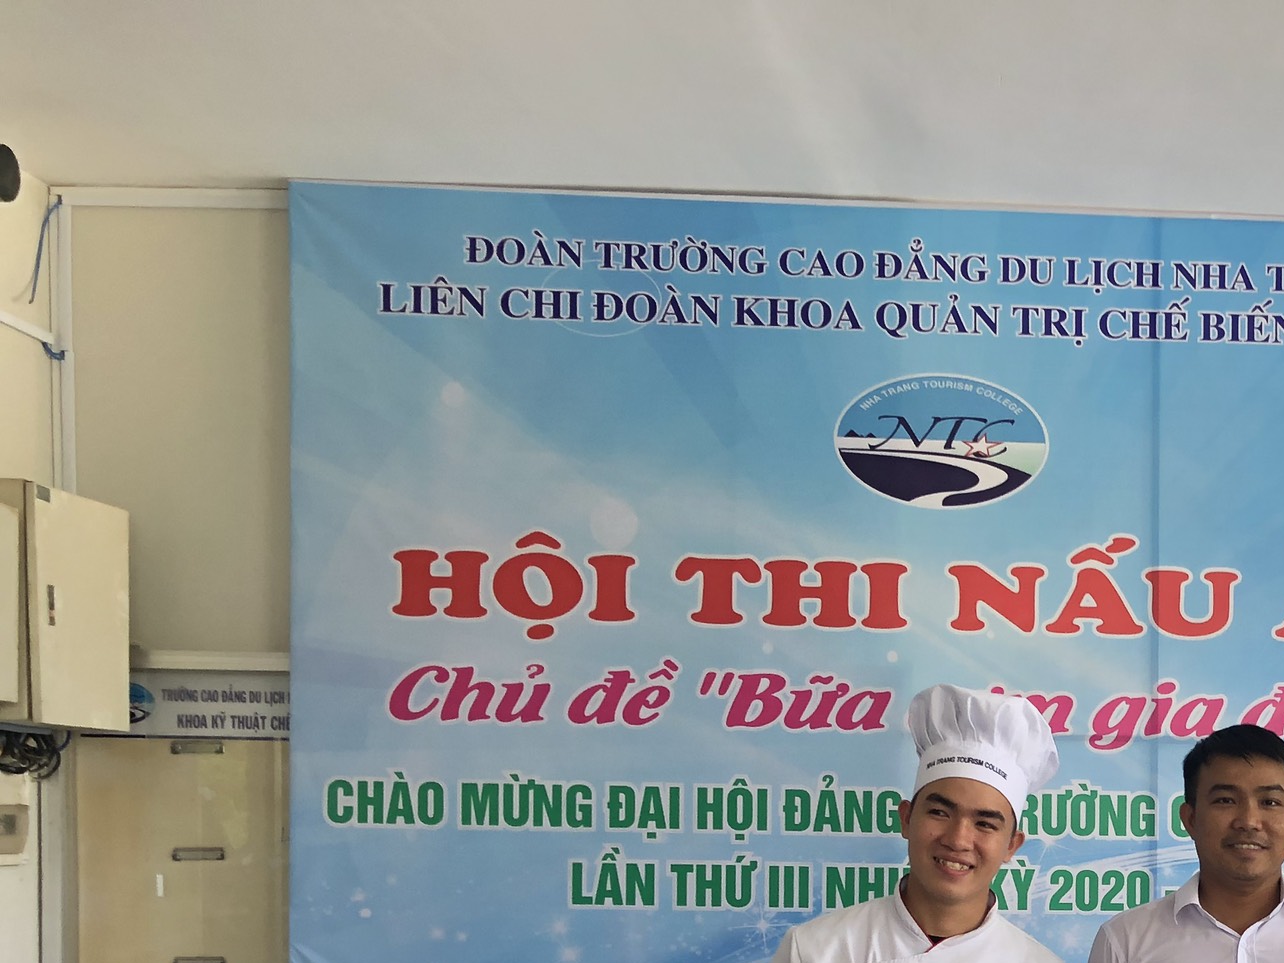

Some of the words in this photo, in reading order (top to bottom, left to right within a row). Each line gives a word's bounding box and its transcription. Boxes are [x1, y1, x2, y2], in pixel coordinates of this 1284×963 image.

[465, 229, 584, 268] ĐOÀN
[593, 238, 766, 277] TRƯỜNG
[778, 248, 865, 279] CAO
[875, 237, 988, 286] ĐẲNG
[1000, 255, 1054, 287] DU
[1065, 258, 1162, 294] LỊCH
[1172, 261, 1256, 292] NHA
[379, 276, 487, 318] LIÊN
[500, 287, 583, 322] CHI
[593, 284, 720, 327] ĐOÀN
[732, 296, 862, 331] KHOA
[875, 293, 1000, 339] QUẢN
[1012, 306, 1087, 346] TRỊ
[1098, 296, 1191, 342] CHẾ
[859, 395, 883, 412] NHA
[881, 380, 920, 400] TRANG
[923, 380, 974, 392] TOURISM
[976, 386, 1024, 416] COLLEGE
[867, 414, 1016, 459] NTC
[391, 530, 637, 641] HỘI
[674, 555, 909, 629] THI
[949, 534, 1239, 640] NẤU
[161, 686, 198, 703] TRƯỜNG
[200, 689, 219, 703] CAO
[221, 683, 247, 704] ĐẲNG
[249, 690, 262, 704] DU
[264, 691, 285, 707] LỊCH
[176, 713, 208, 730] KHOA
[211, 711, 227, 730] KỸ
[230, 712, 267, 733] THUẬT
[388, 662, 552, 724] Chủ
[567, 658, 680, 727] đề
[699, 670, 894, 732] "Bữa
[1089, 681, 1223, 750] gia
[936, 756, 956, 765] TRANG
[956, 756, 984, 767] TOURISM
[984, 761, 1008, 781] COLLEGE
[325, 771, 444, 826] CHÀO
[460, 773, 594, 829] MỪNG
[607, 784, 681, 840] ĐẠI
[695, 778, 769, 842] HỘI
[781, 775, 903, 834] ĐẢNG
[1018, 783, 1156, 837] RƯỜNG
[570, 847, 656, 907] LẦN
[671, 855, 757, 909] THỨ
[768, 865, 811, 909] III
[1048, 869, 1151, 912] 2020
